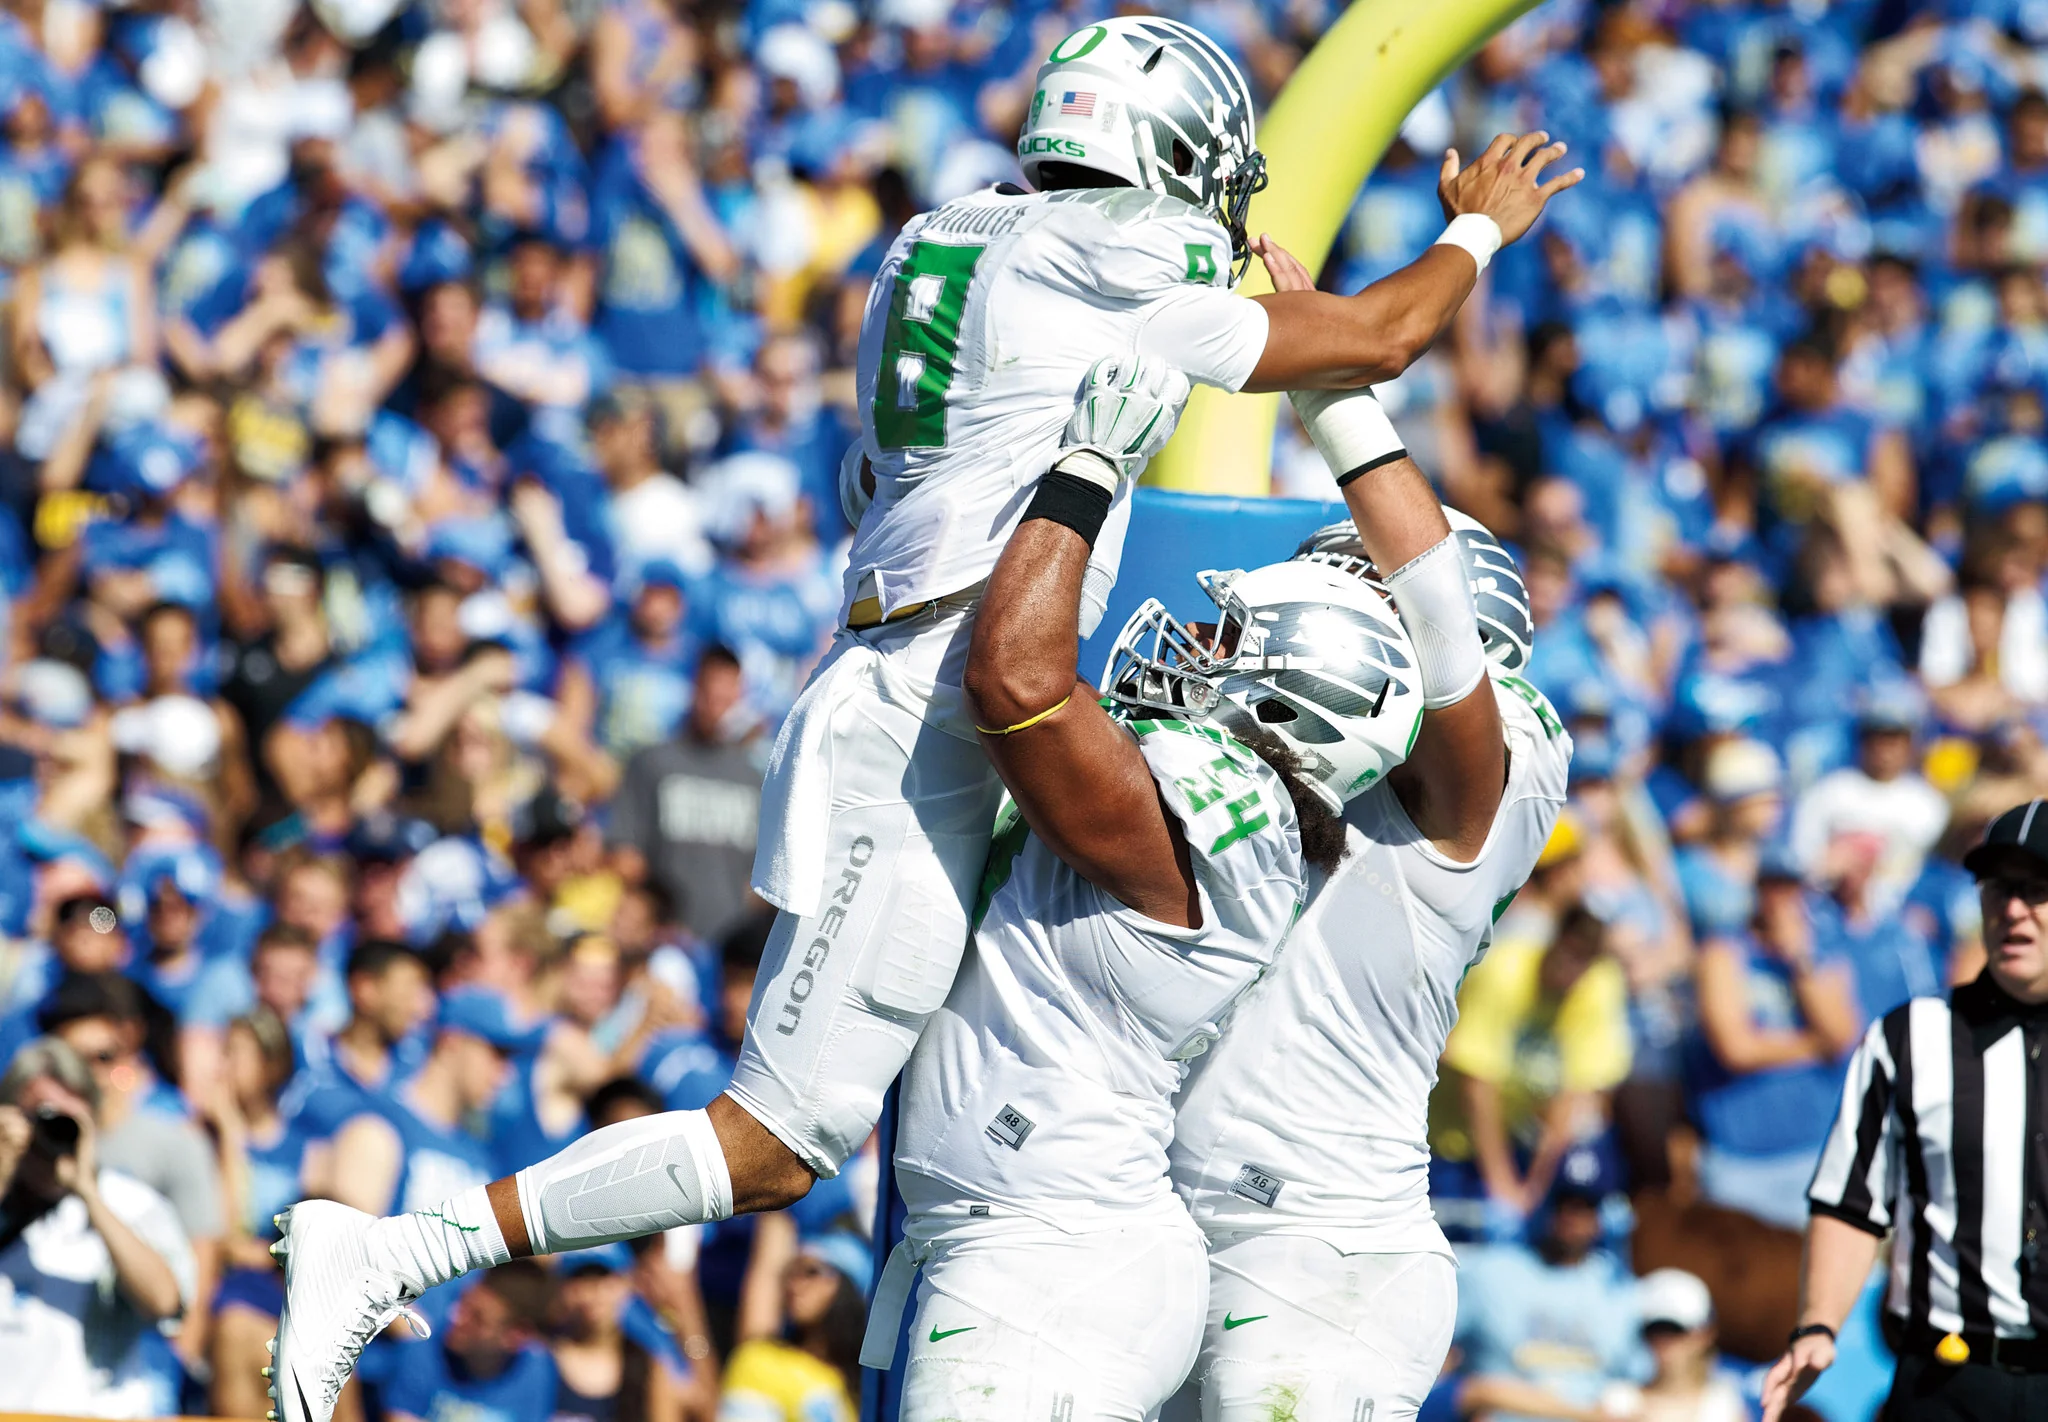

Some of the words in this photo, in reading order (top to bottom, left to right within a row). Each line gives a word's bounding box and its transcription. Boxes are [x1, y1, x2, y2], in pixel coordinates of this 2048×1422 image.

[872, 240, 988, 450] 8
[776, 834, 875, 1037] OREGON
[1004, 1113, 1020, 1127] 48
[1251, 1175, 1269, 1188] 46
